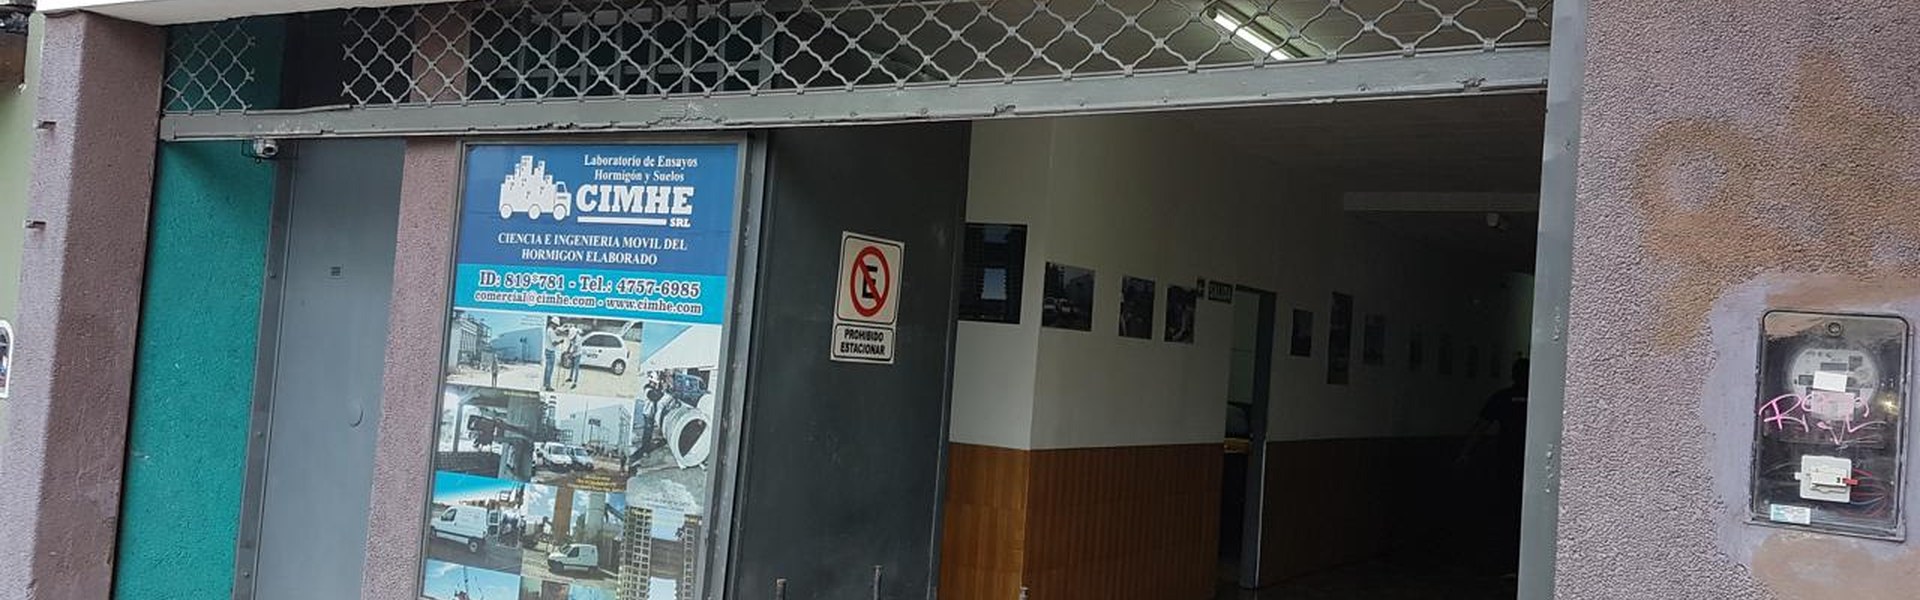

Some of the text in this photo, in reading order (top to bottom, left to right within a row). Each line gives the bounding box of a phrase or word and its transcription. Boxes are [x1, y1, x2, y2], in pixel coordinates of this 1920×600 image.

[584, 154, 698, 170] Laboratorio de Ensayos
[595, 169, 685, 184] Hormigón y Suelos
[576, 184, 695, 215] CIMHE
[669, 218, 691, 228] SRL
[498, 232, 688, 250] CIENCIA E INGENIERIA MOVIL DEL
[522, 248, 658, 265] HORMIGON ELABORADO
[479, 271, 500, 286] ID:
[580, 275, 612, 292] Tel.:
[616, 277, 700, 298] 4757-6985
[475, 291, 595, 308] comercial@cimhe.com
[605, 298, 702, 315] www.cimhe.com
[844, 328, 884, 342] PROHIBIDO
[840, 341, 885, 356] ESTACIONAR
